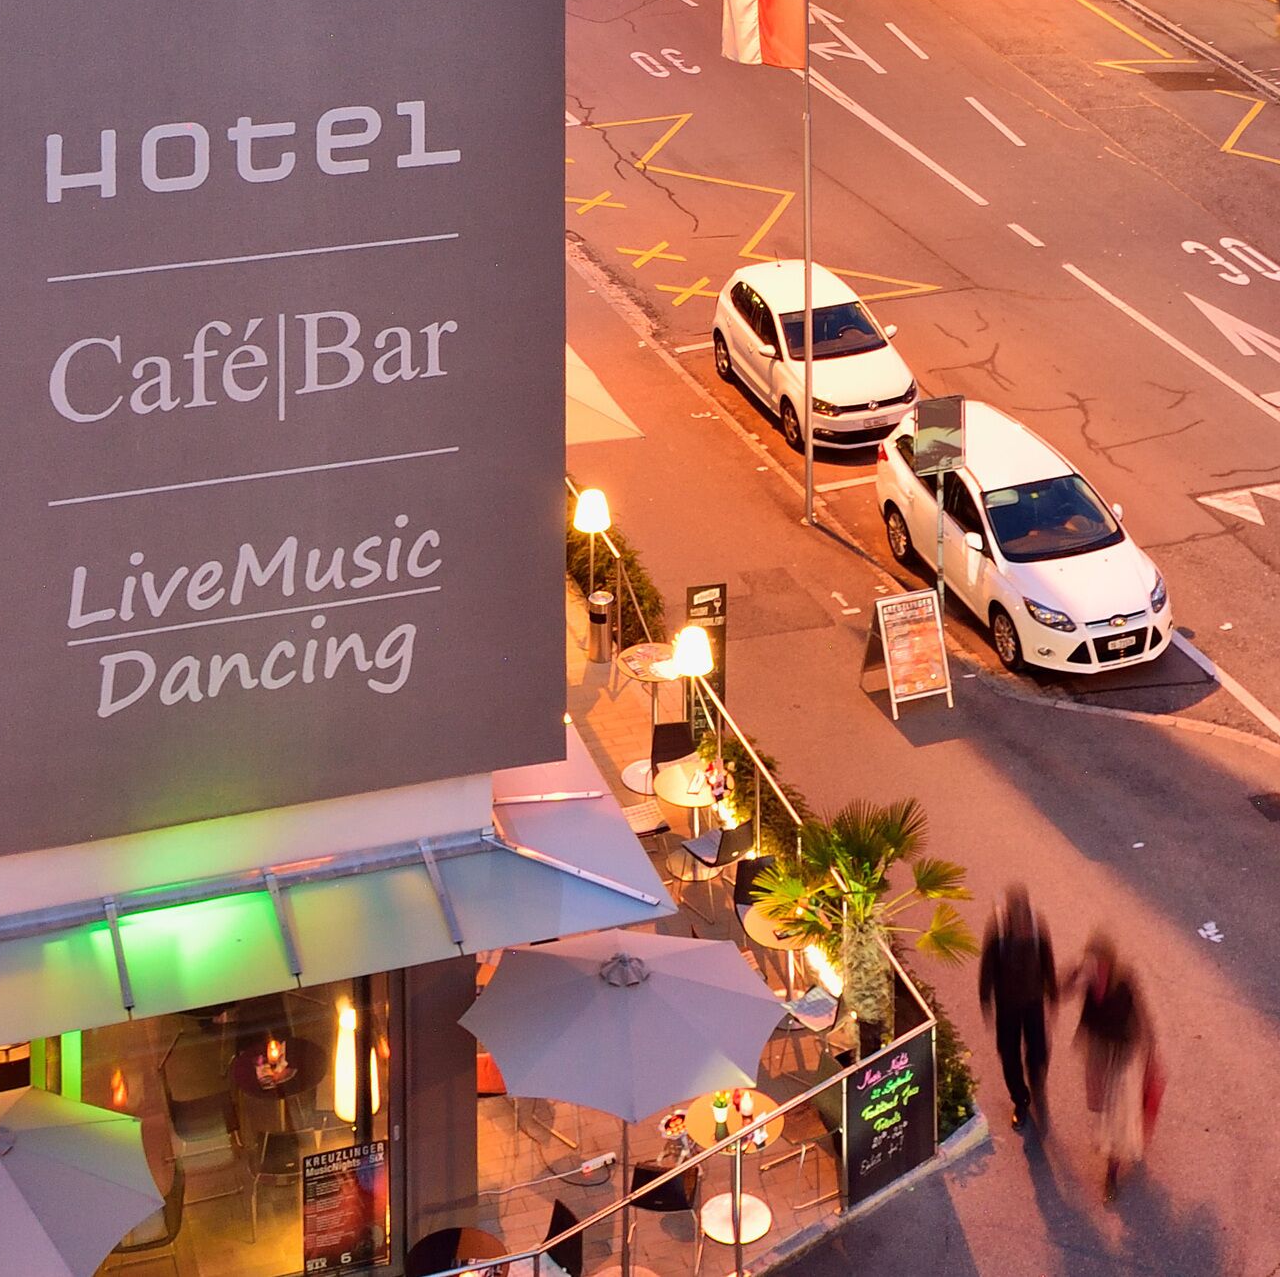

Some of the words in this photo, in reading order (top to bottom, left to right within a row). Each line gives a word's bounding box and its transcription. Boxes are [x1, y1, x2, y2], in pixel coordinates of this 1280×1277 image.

[48, 317, 268, 423] Café
[295, 309, 458, 395] Bar
[97, 616, 417, 718] Dancing
[305, 1142, 384, 1168] KREUZLINGER
[340, 1252, 352, 1264] 6
